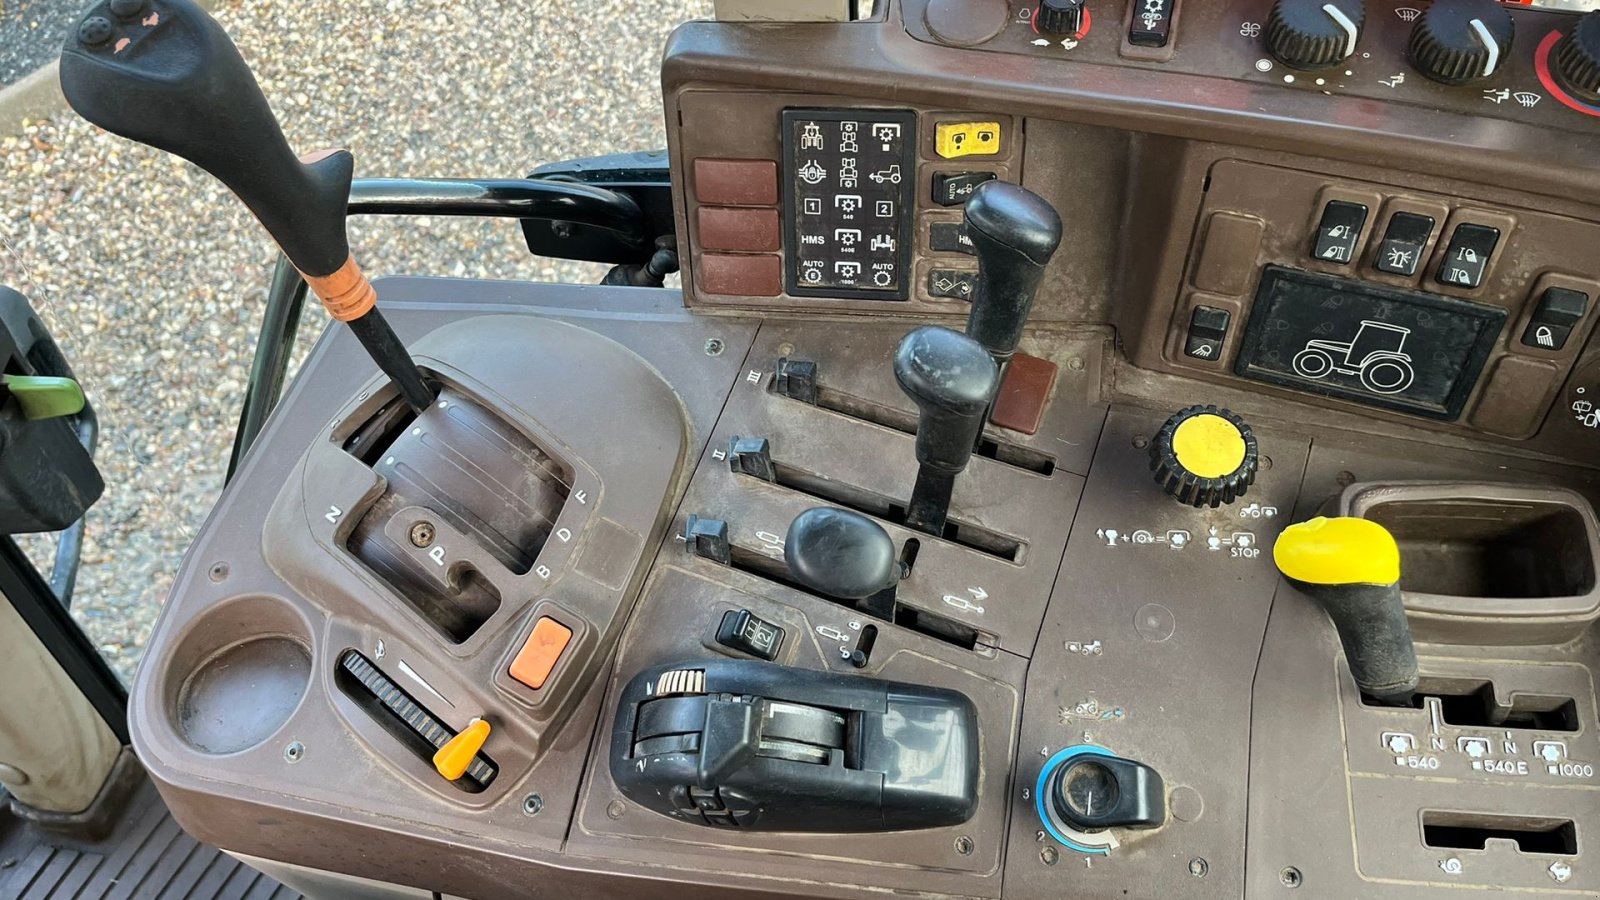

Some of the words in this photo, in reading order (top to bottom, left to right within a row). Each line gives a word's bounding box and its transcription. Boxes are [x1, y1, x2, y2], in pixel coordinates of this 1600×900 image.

[949, 183, 957, 200] AUTO
[809, 202, 816, 211] 1
[881, 204, 888, 214] 2
[801, 235, 825, 245] HMS
[959, 234, 973, 246] HM
[802, 260, 824, 268] AUTO
[747, 370, 762, 384] III
[712, 449, 726, 461] II
[575, 490, 587, 504] F
[325, 505, 343, 523] N
[556, 528, 572, 543] D
[428, 546, 446, 566] P
[1230, 548, 1260, 558] STOP
[535, 565, 551, 579] B
[1084, 732, 1092, 743] 5
[1431, 737, 1445, 750] N
[1040, 746, 1049, 757] 4
[1504, 741, 1517, 755] N
[1408, 756, 1439, 769] 540
[1559, 764, 1594, 778] 1000
[1022, 789, 1030, 800] 3
[1037, 831, 1046, 842] 2
[1085, 857, 1092, 868] 1
